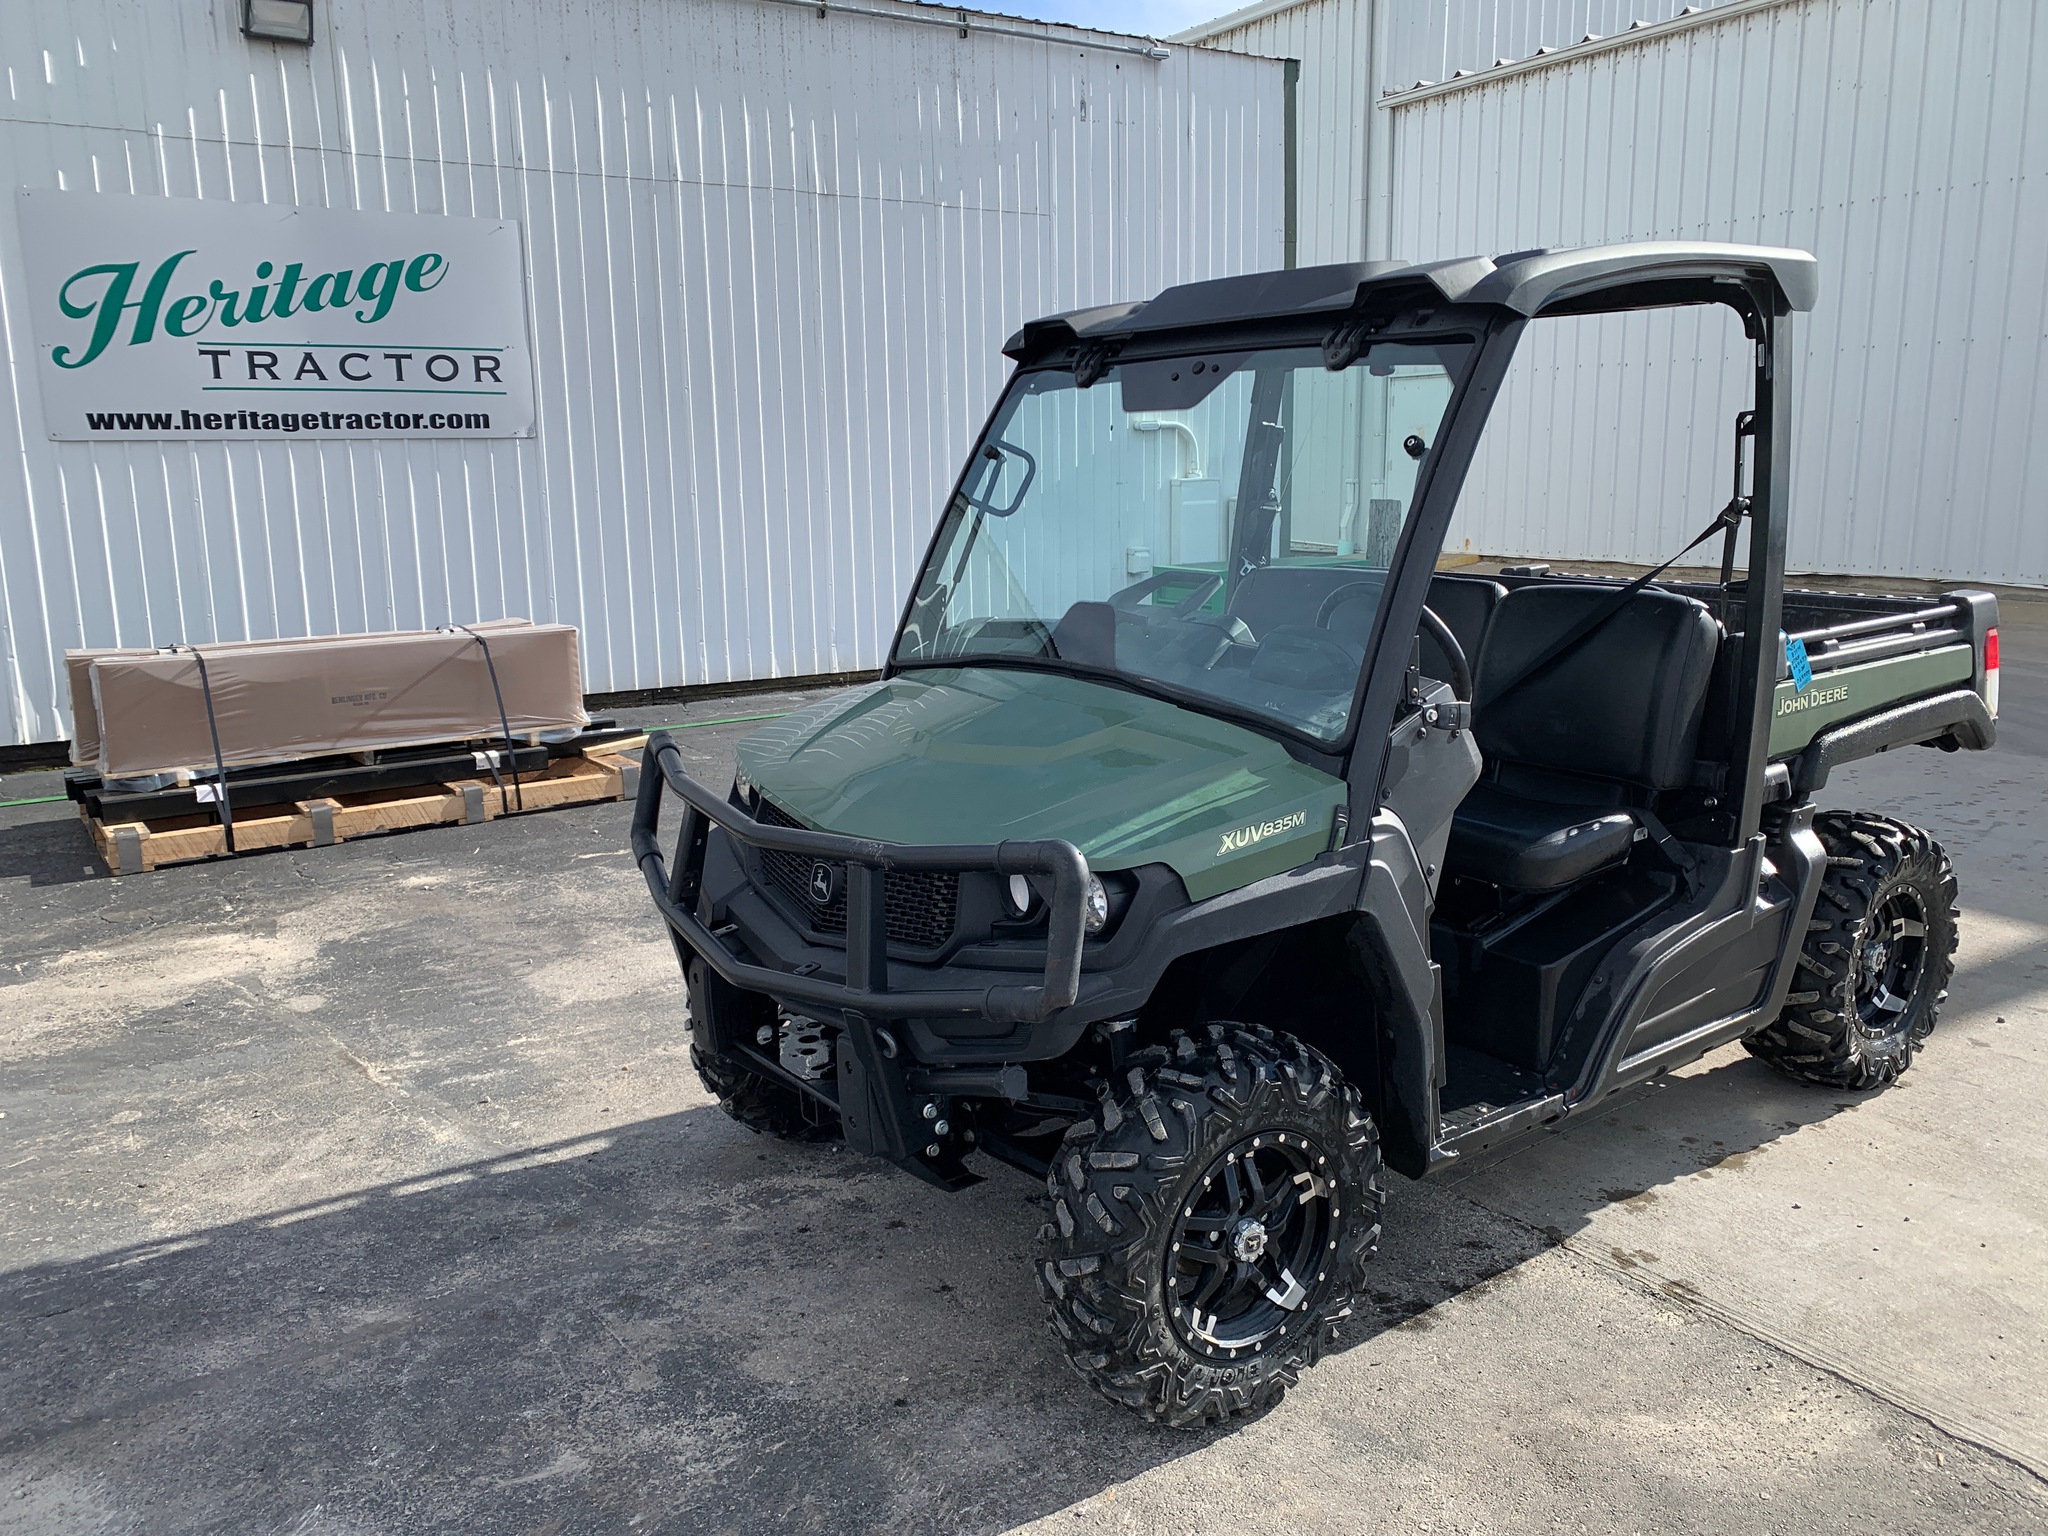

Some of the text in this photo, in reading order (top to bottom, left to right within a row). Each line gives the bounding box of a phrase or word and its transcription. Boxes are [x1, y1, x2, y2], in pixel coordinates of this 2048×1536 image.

[51, 249, 449, 369] Heritage
[198, 347, 503, 384] TRACTOR
[86, 409, 490, 432] www.heritagetractor.com
[1777, 686, 1848, 716] JOHN DEERE
[1218, 810, 1306, 854] XUV835M
